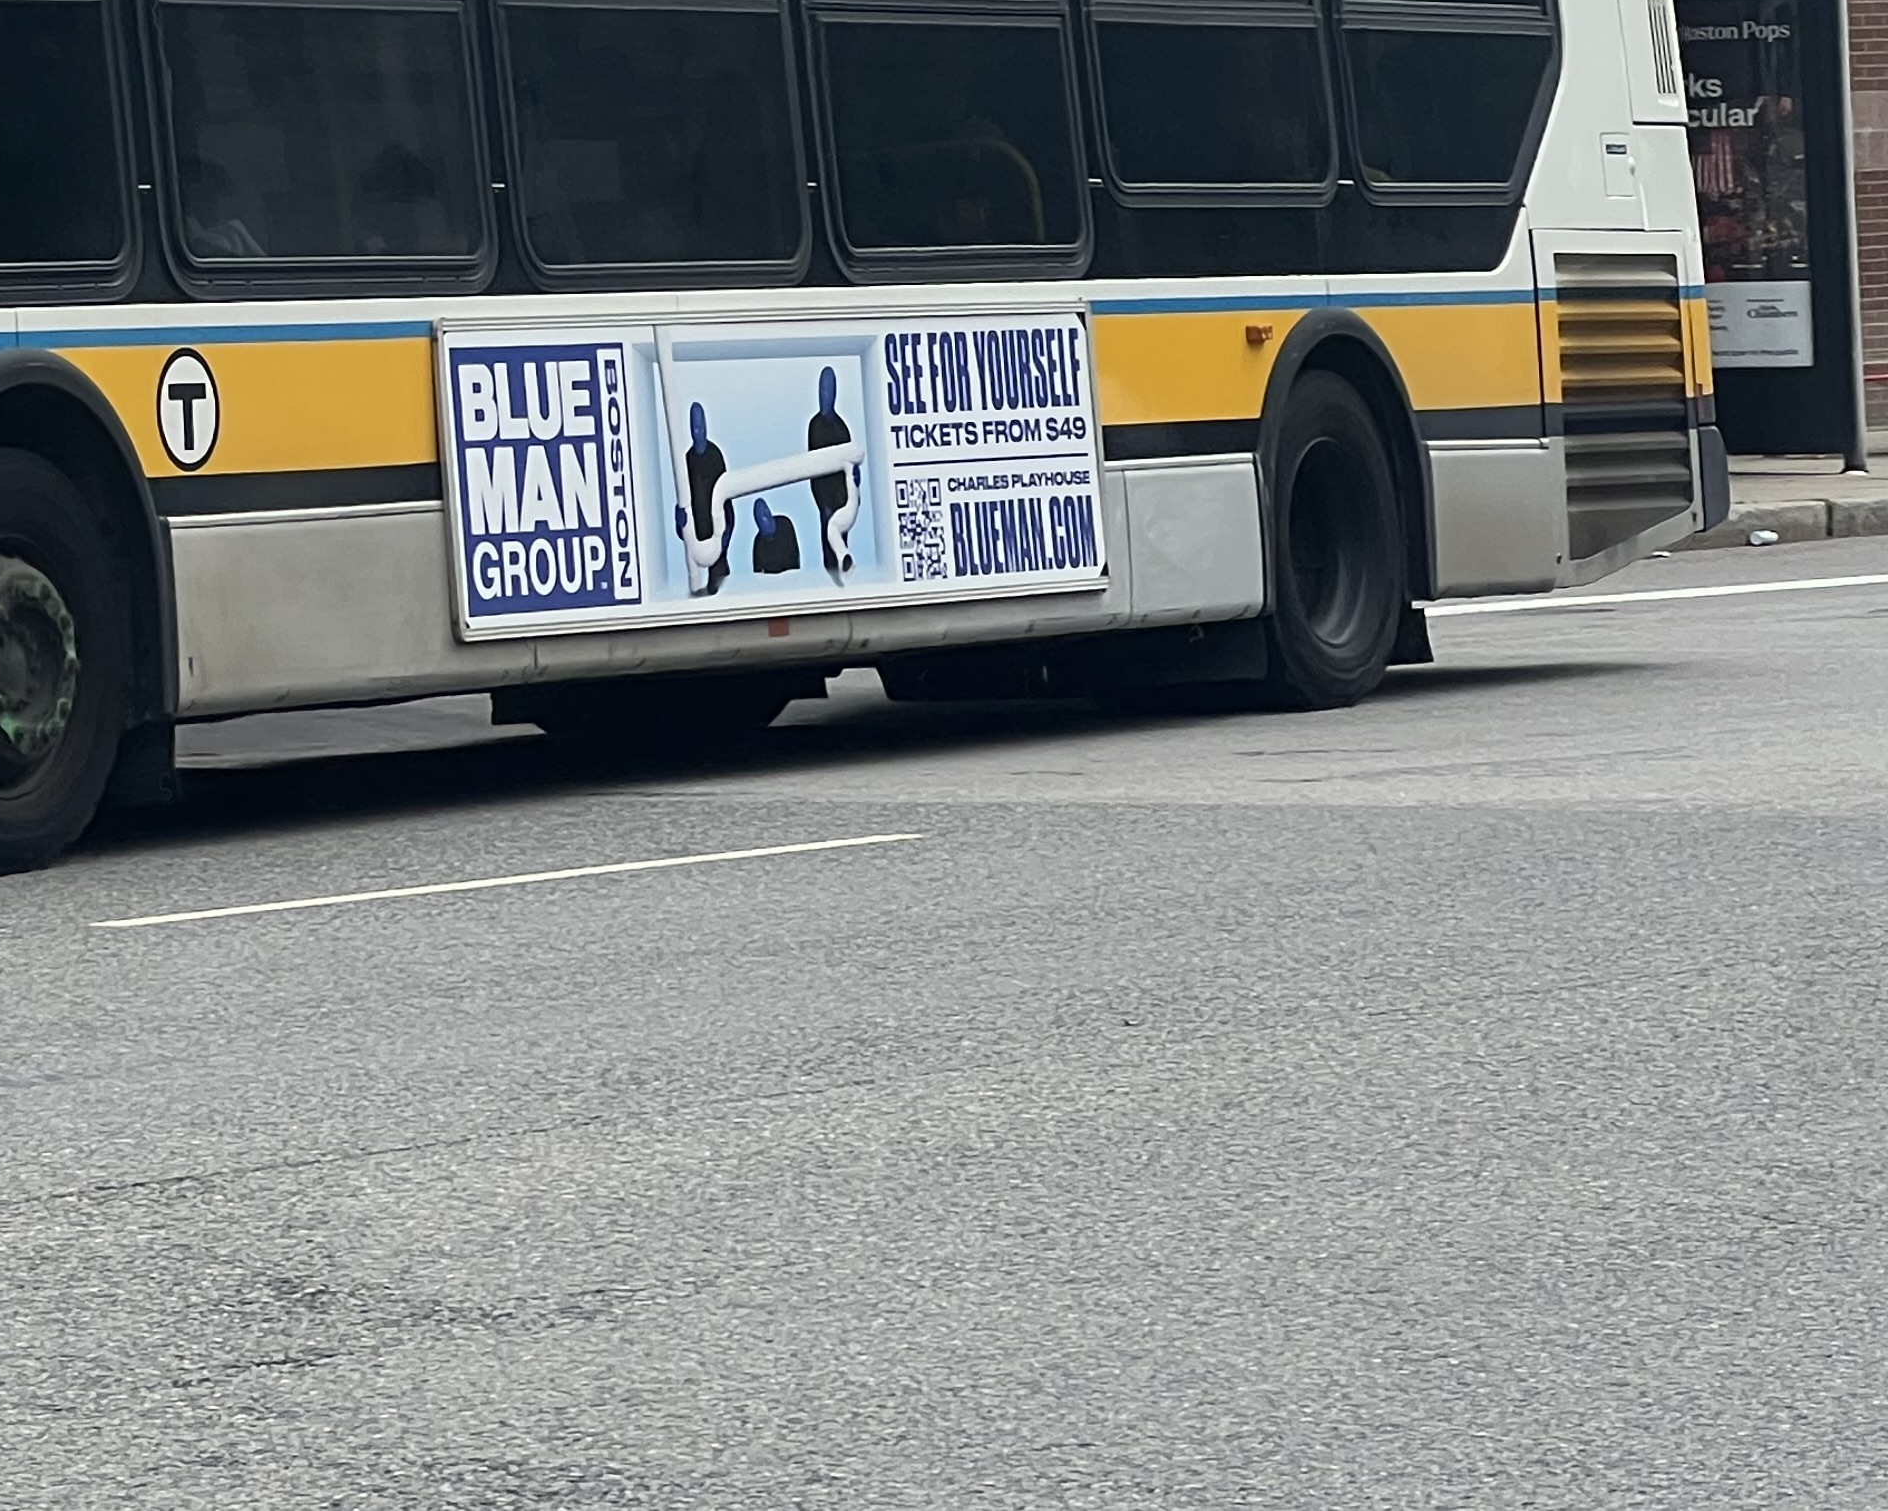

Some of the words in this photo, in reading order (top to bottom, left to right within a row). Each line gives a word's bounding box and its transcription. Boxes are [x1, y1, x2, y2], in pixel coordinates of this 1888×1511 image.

[1742, 20, 1791, 42] Pops
[1685, 72, 1723, 98] ks
[458, 360, 596, 441] BLUE
[884, 334, 927, 415] SEE
[927, 331, 974, 413] FOR
[974, 328, 1081, 411] YOURSELF
[168, 383, 206, 450] T
[890, 421, 979, 450] TICKETS
[983, 419, 1042, 444] FROM
[464, 443, 603, 535] MAN
[603, 359, 633, 588] BOSTON
[947, 475, 1009, 492] CHARLES
[1011, 470, 1091, 488] PLAYHOUSE
[472, 537, 607, 600] GROUP
[950, 495, 1099, 577] BLUEMAN.COM
